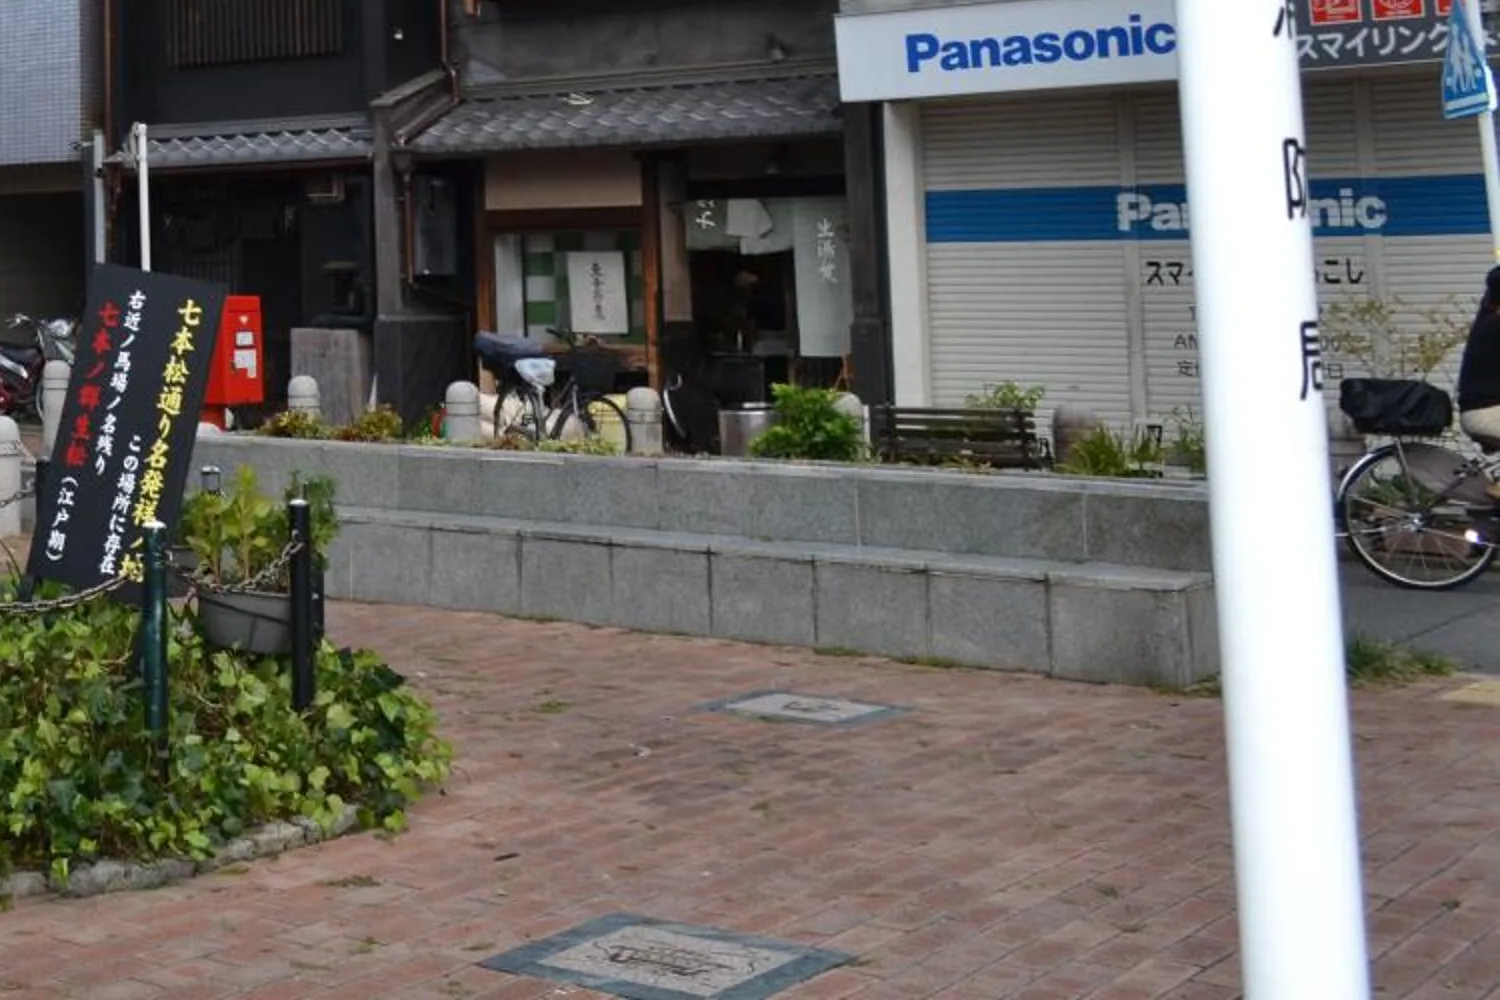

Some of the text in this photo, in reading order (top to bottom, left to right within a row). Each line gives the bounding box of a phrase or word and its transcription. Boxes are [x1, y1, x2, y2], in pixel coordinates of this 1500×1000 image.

[905, 13, 1177, 73] Panasonic
[99, 433, 142, 575] この場所に存在
